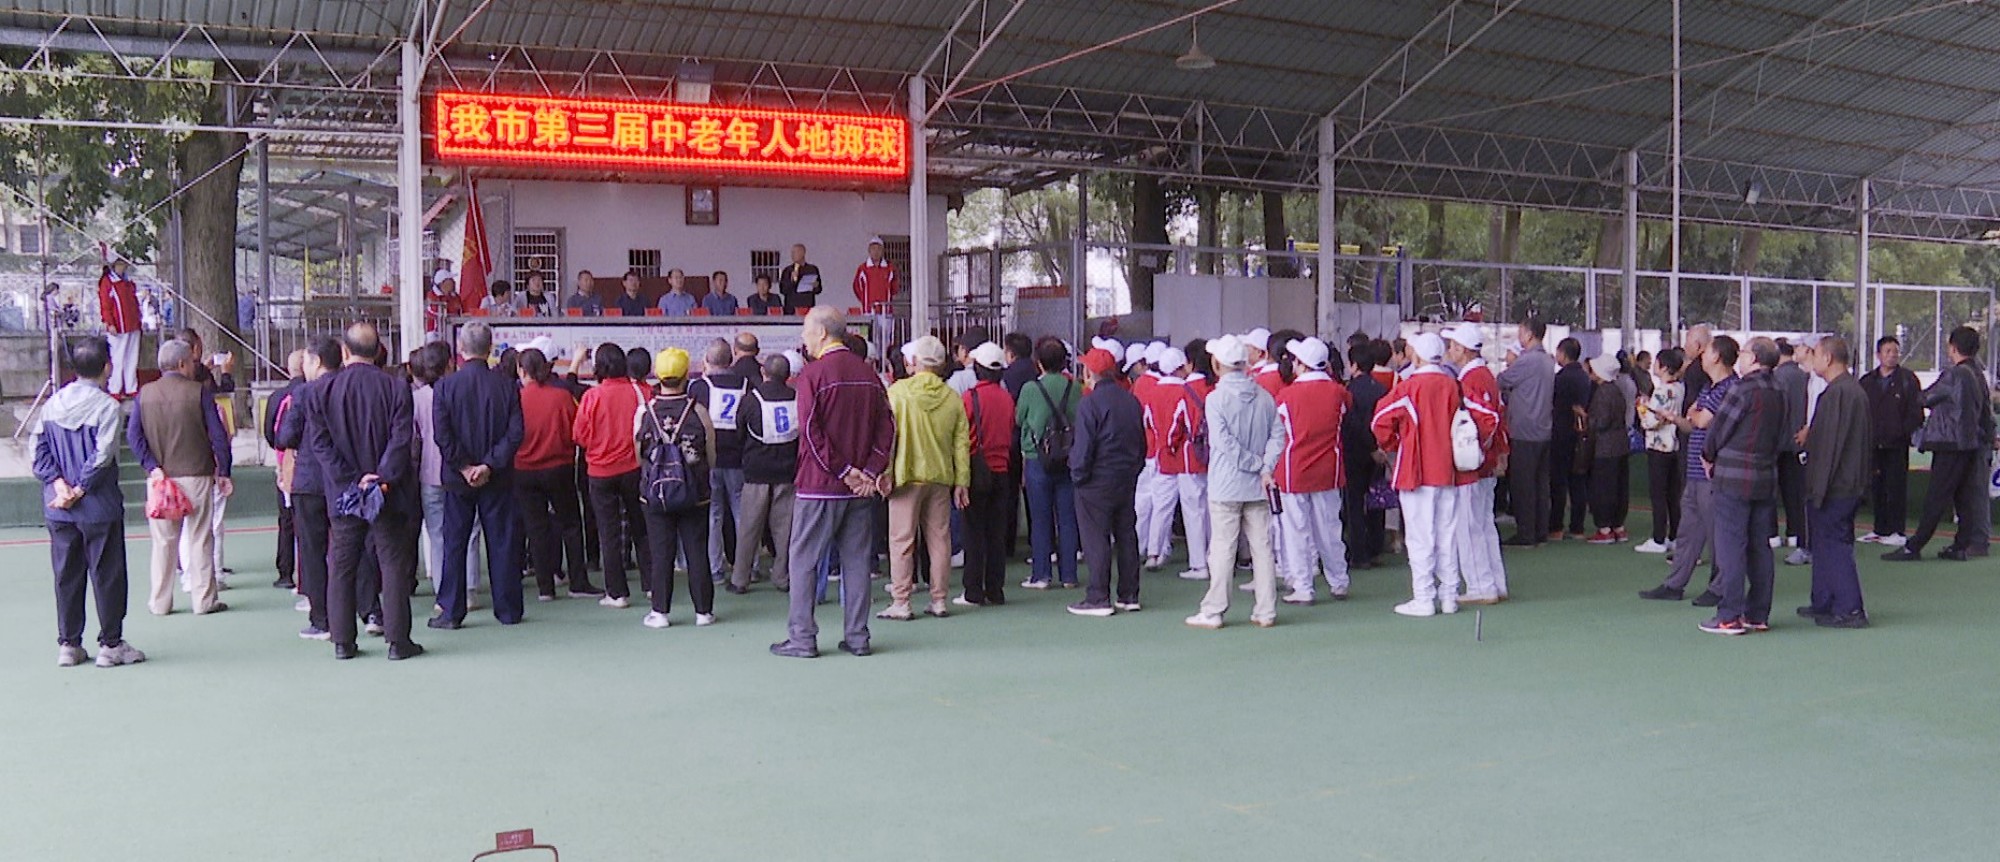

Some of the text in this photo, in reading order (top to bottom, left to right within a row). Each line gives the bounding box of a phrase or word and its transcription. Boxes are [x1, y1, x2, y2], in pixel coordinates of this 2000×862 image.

[440, 102, 898, 162] 我市第三届中老年人地掷球
[720, 393, 736, 420] 2
[774, 406, 790, 433] 6
